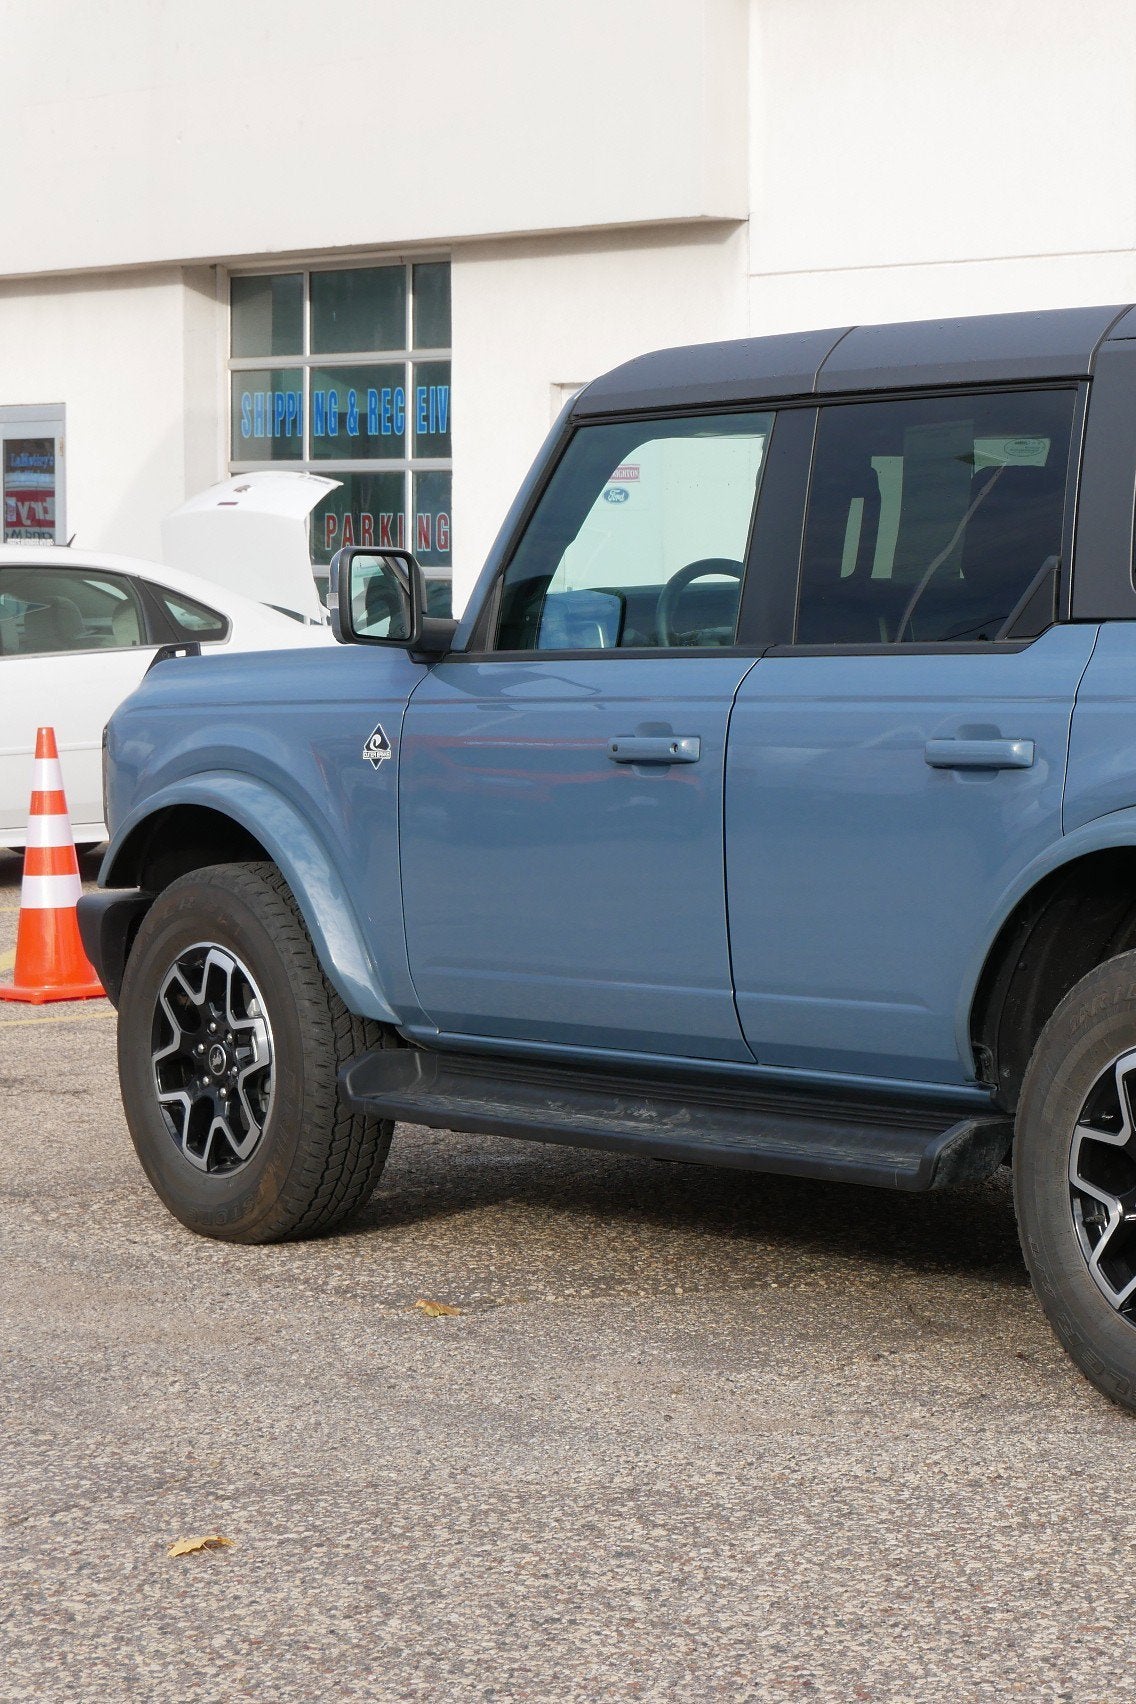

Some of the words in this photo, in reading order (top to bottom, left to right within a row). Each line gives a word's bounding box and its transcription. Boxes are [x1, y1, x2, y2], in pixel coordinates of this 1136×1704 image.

[241, 390, 338, 438] SHIPPING
[346, 388, 360, 436] &
[324, 512, 450, 552] PARKING
